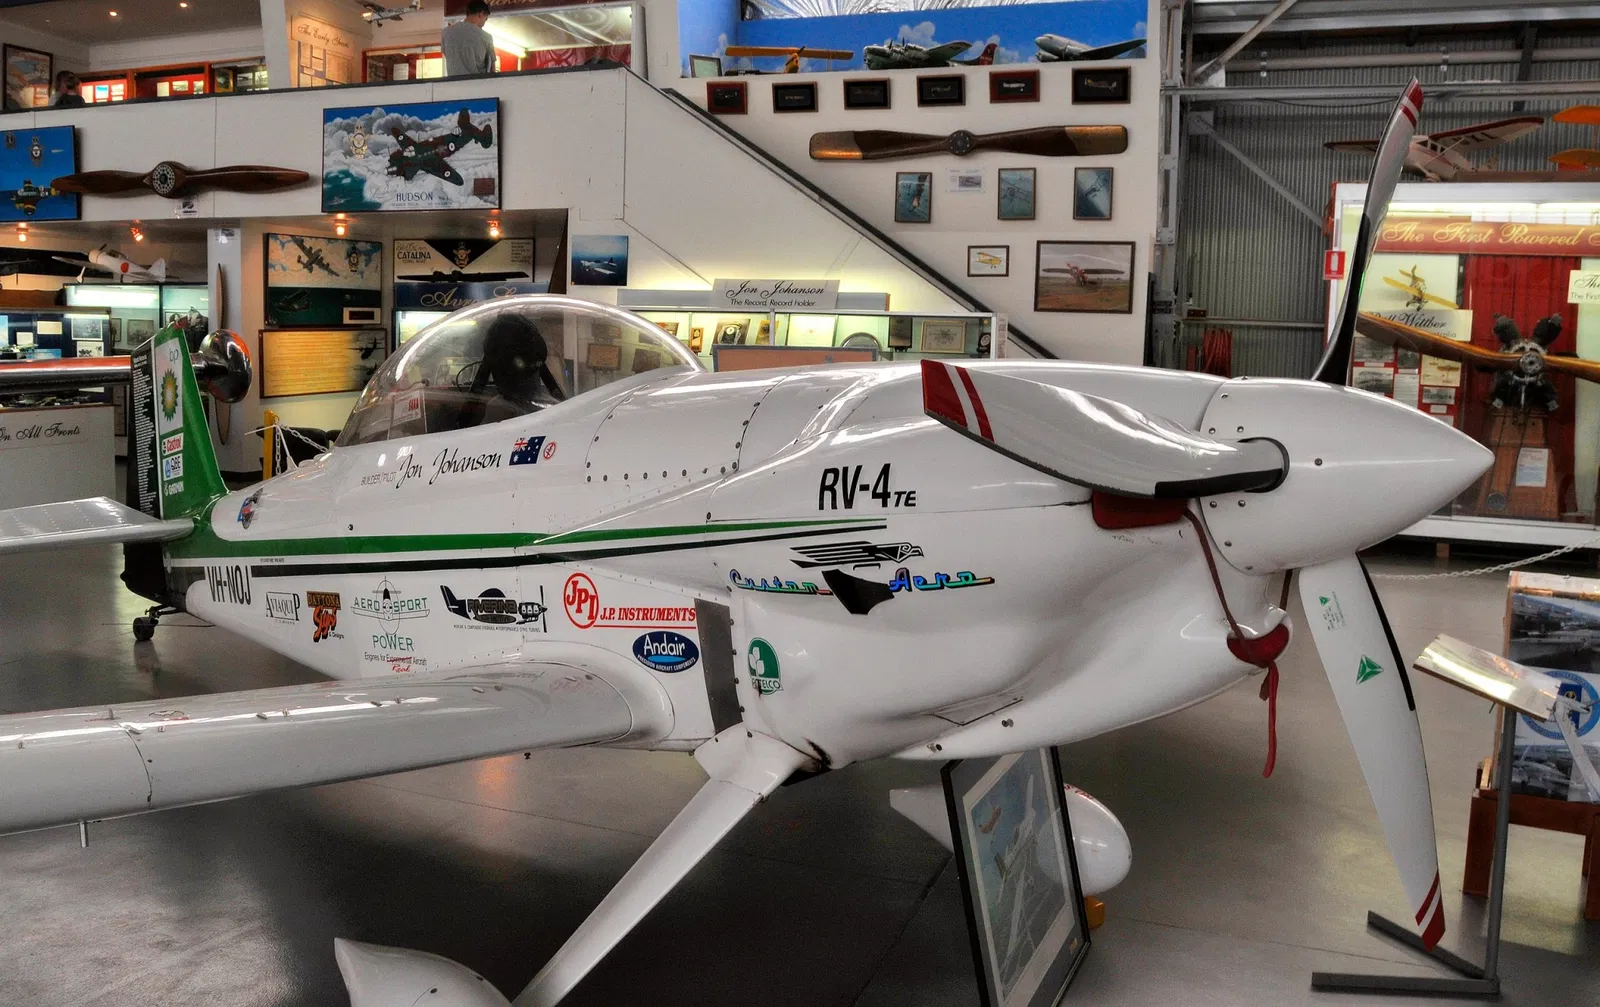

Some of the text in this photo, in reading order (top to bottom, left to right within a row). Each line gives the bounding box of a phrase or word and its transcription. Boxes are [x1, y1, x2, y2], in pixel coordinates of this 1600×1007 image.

[396, 191, 433, 202] HUDSON
[1382, 221, 1425, 243] The
[1433, 222, 1495, 244] First
[1498, 222, 1585, 245] Powered
[396, 250, 431, 260] CATALINA
[725, 280, 824, 300] Jon Johanson
[730, 298, 742, 306] The
[769, 299, 793, 307] Record
[169, 347, 179, 365] bp
[16, 424, 43, 440] All
[44, 422, 80, 438] Fronts
[396, 453, 423, 489] Jon
[429, 447, 502, 485] Johanson
[818, 463, 916, 511] RV-4 TE
[206, 564, 252, 606] VH-NOJ
[729, 567, 995, 595] Custom Aero
[353, 597, 428, 612] AERO SPORT
[566, 580, 697, 622] JPI J.P. INSTRUMENTS
[372, 634, 415, 651] POWER
[643, 633, 686, 656] Andair
